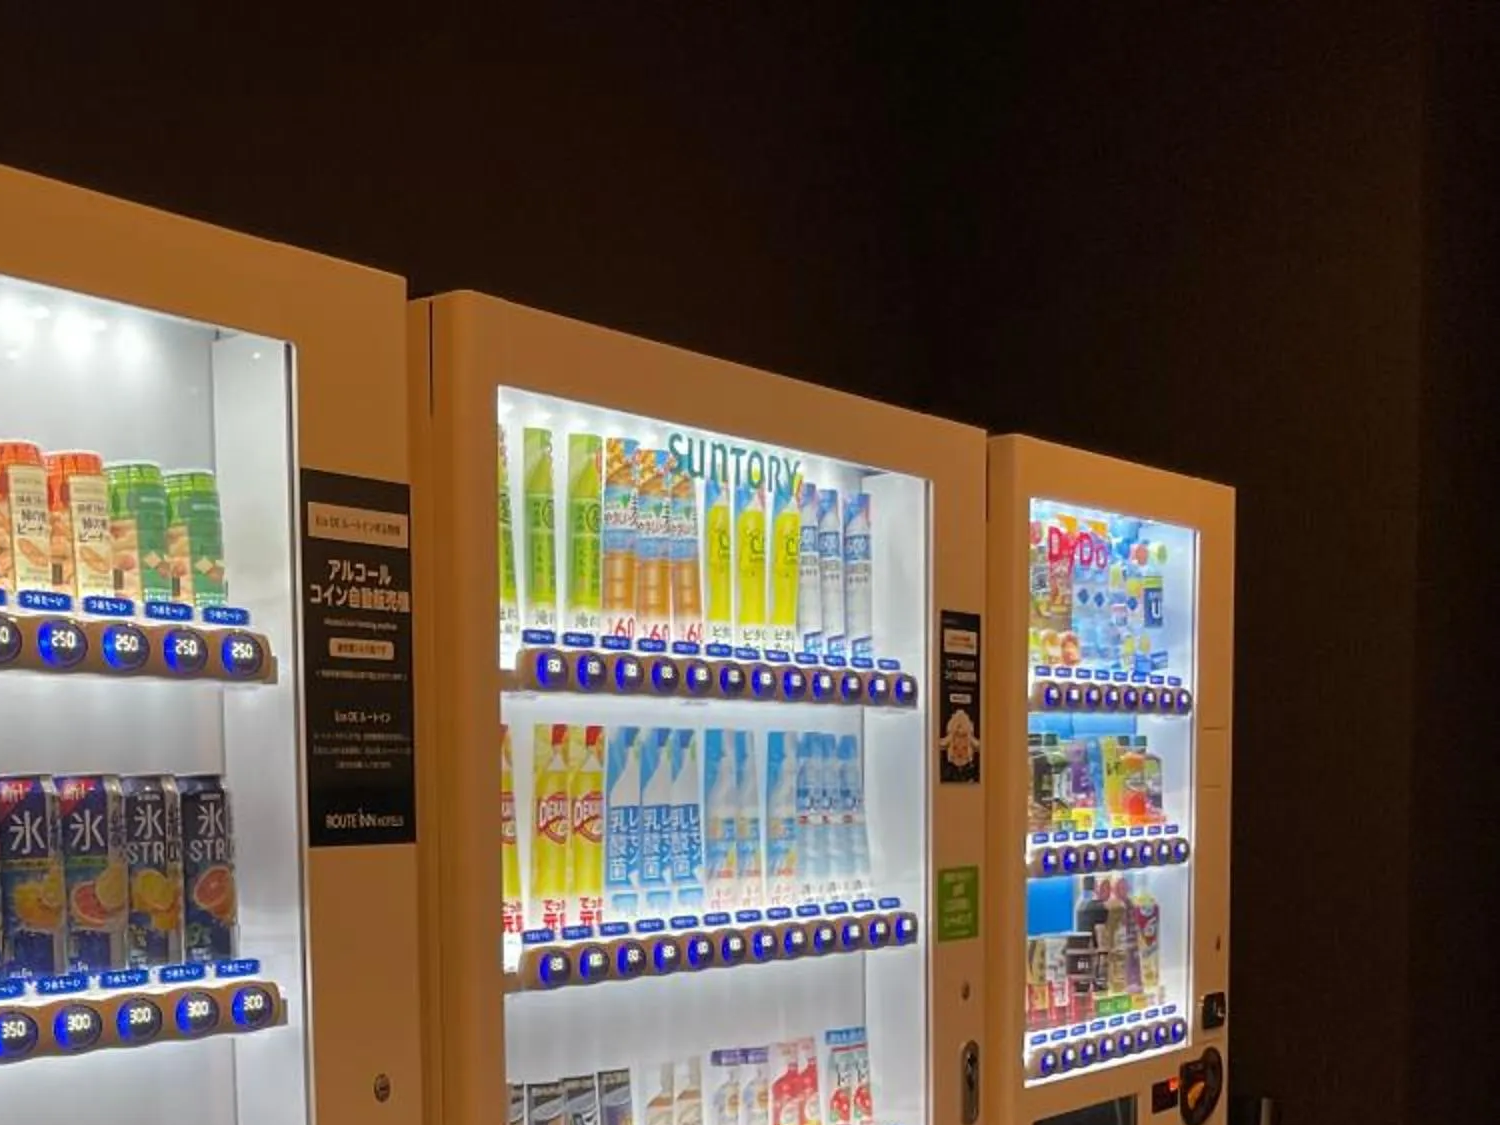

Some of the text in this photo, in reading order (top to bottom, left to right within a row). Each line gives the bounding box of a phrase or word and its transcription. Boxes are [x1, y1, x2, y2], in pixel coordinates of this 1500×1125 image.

[668, 433, 801, 493] SUNTORY
[328, 559, 392, 585] アルコール
[51, 631, 76, 649] 250
[115, 634, 139, 652] 250
[70, 808, 105, 851] 氷
[133, 803, 166, 840] 氷
[197, 802, 225, 838] 氷
[9, 810, 46, 855] 氷
[126, 840, 166, 866] STR
[190, 839, 226, 862] STR
[129, 1007, 151, 1024] 300
[187, 1001, 210, 1016] 300
[1, 1020, 27, 1039] 350
[67, 1013, 92, 1031] 300
